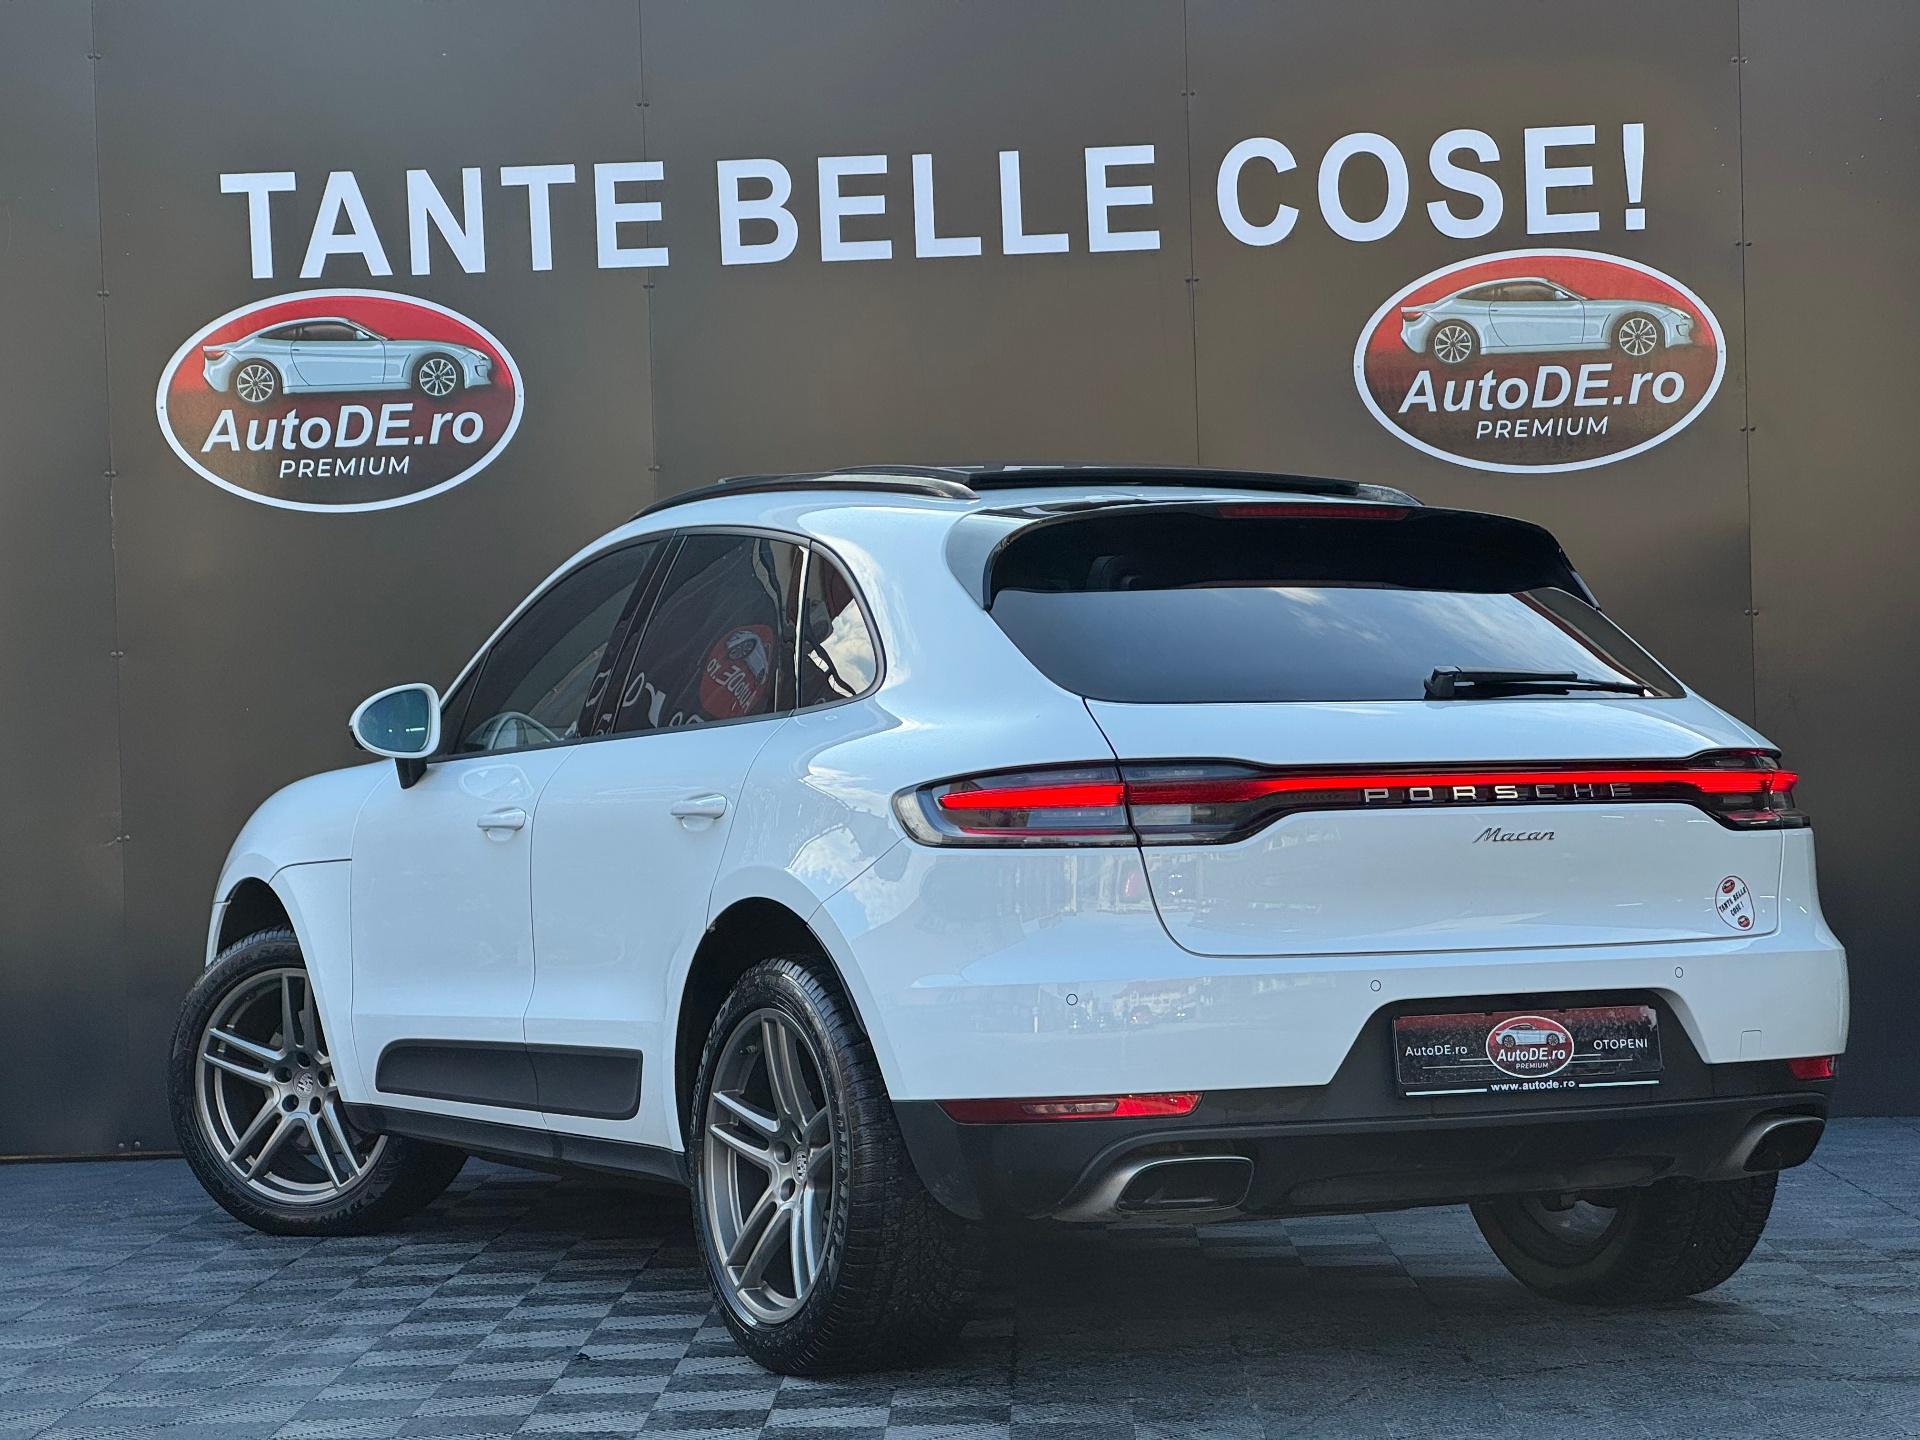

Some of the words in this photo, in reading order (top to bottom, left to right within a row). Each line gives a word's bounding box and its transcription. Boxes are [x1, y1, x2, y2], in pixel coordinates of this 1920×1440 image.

[220, 160, 670, 280] TANTE
[716, 144, 1161, 266] BELLE
[1216, 122, 1648, 249] COSE!
[1398, 363, 1685, 414] AutoDE.ro
[201, 402, 485, 453] AutoDE.ro
[1476, 415, 1609, 439] PREMIUM
[279, 455, 410, 478] PREMIUM
[1363, 783, 1634, 803] PORSCHE
[1472, 827, 1555, 843] Macan
[1405, 1045, 1468, 1057] AutoDE.ro
[1593, 1038, 1648, 1050] OTOPENI
[1496, 1047, 1566, 1063] AutoDE.ro
[1515, 1061, 1549, 1070] PREMIUM
[1490, 1079, 1576, 1092] www.autode.ro
